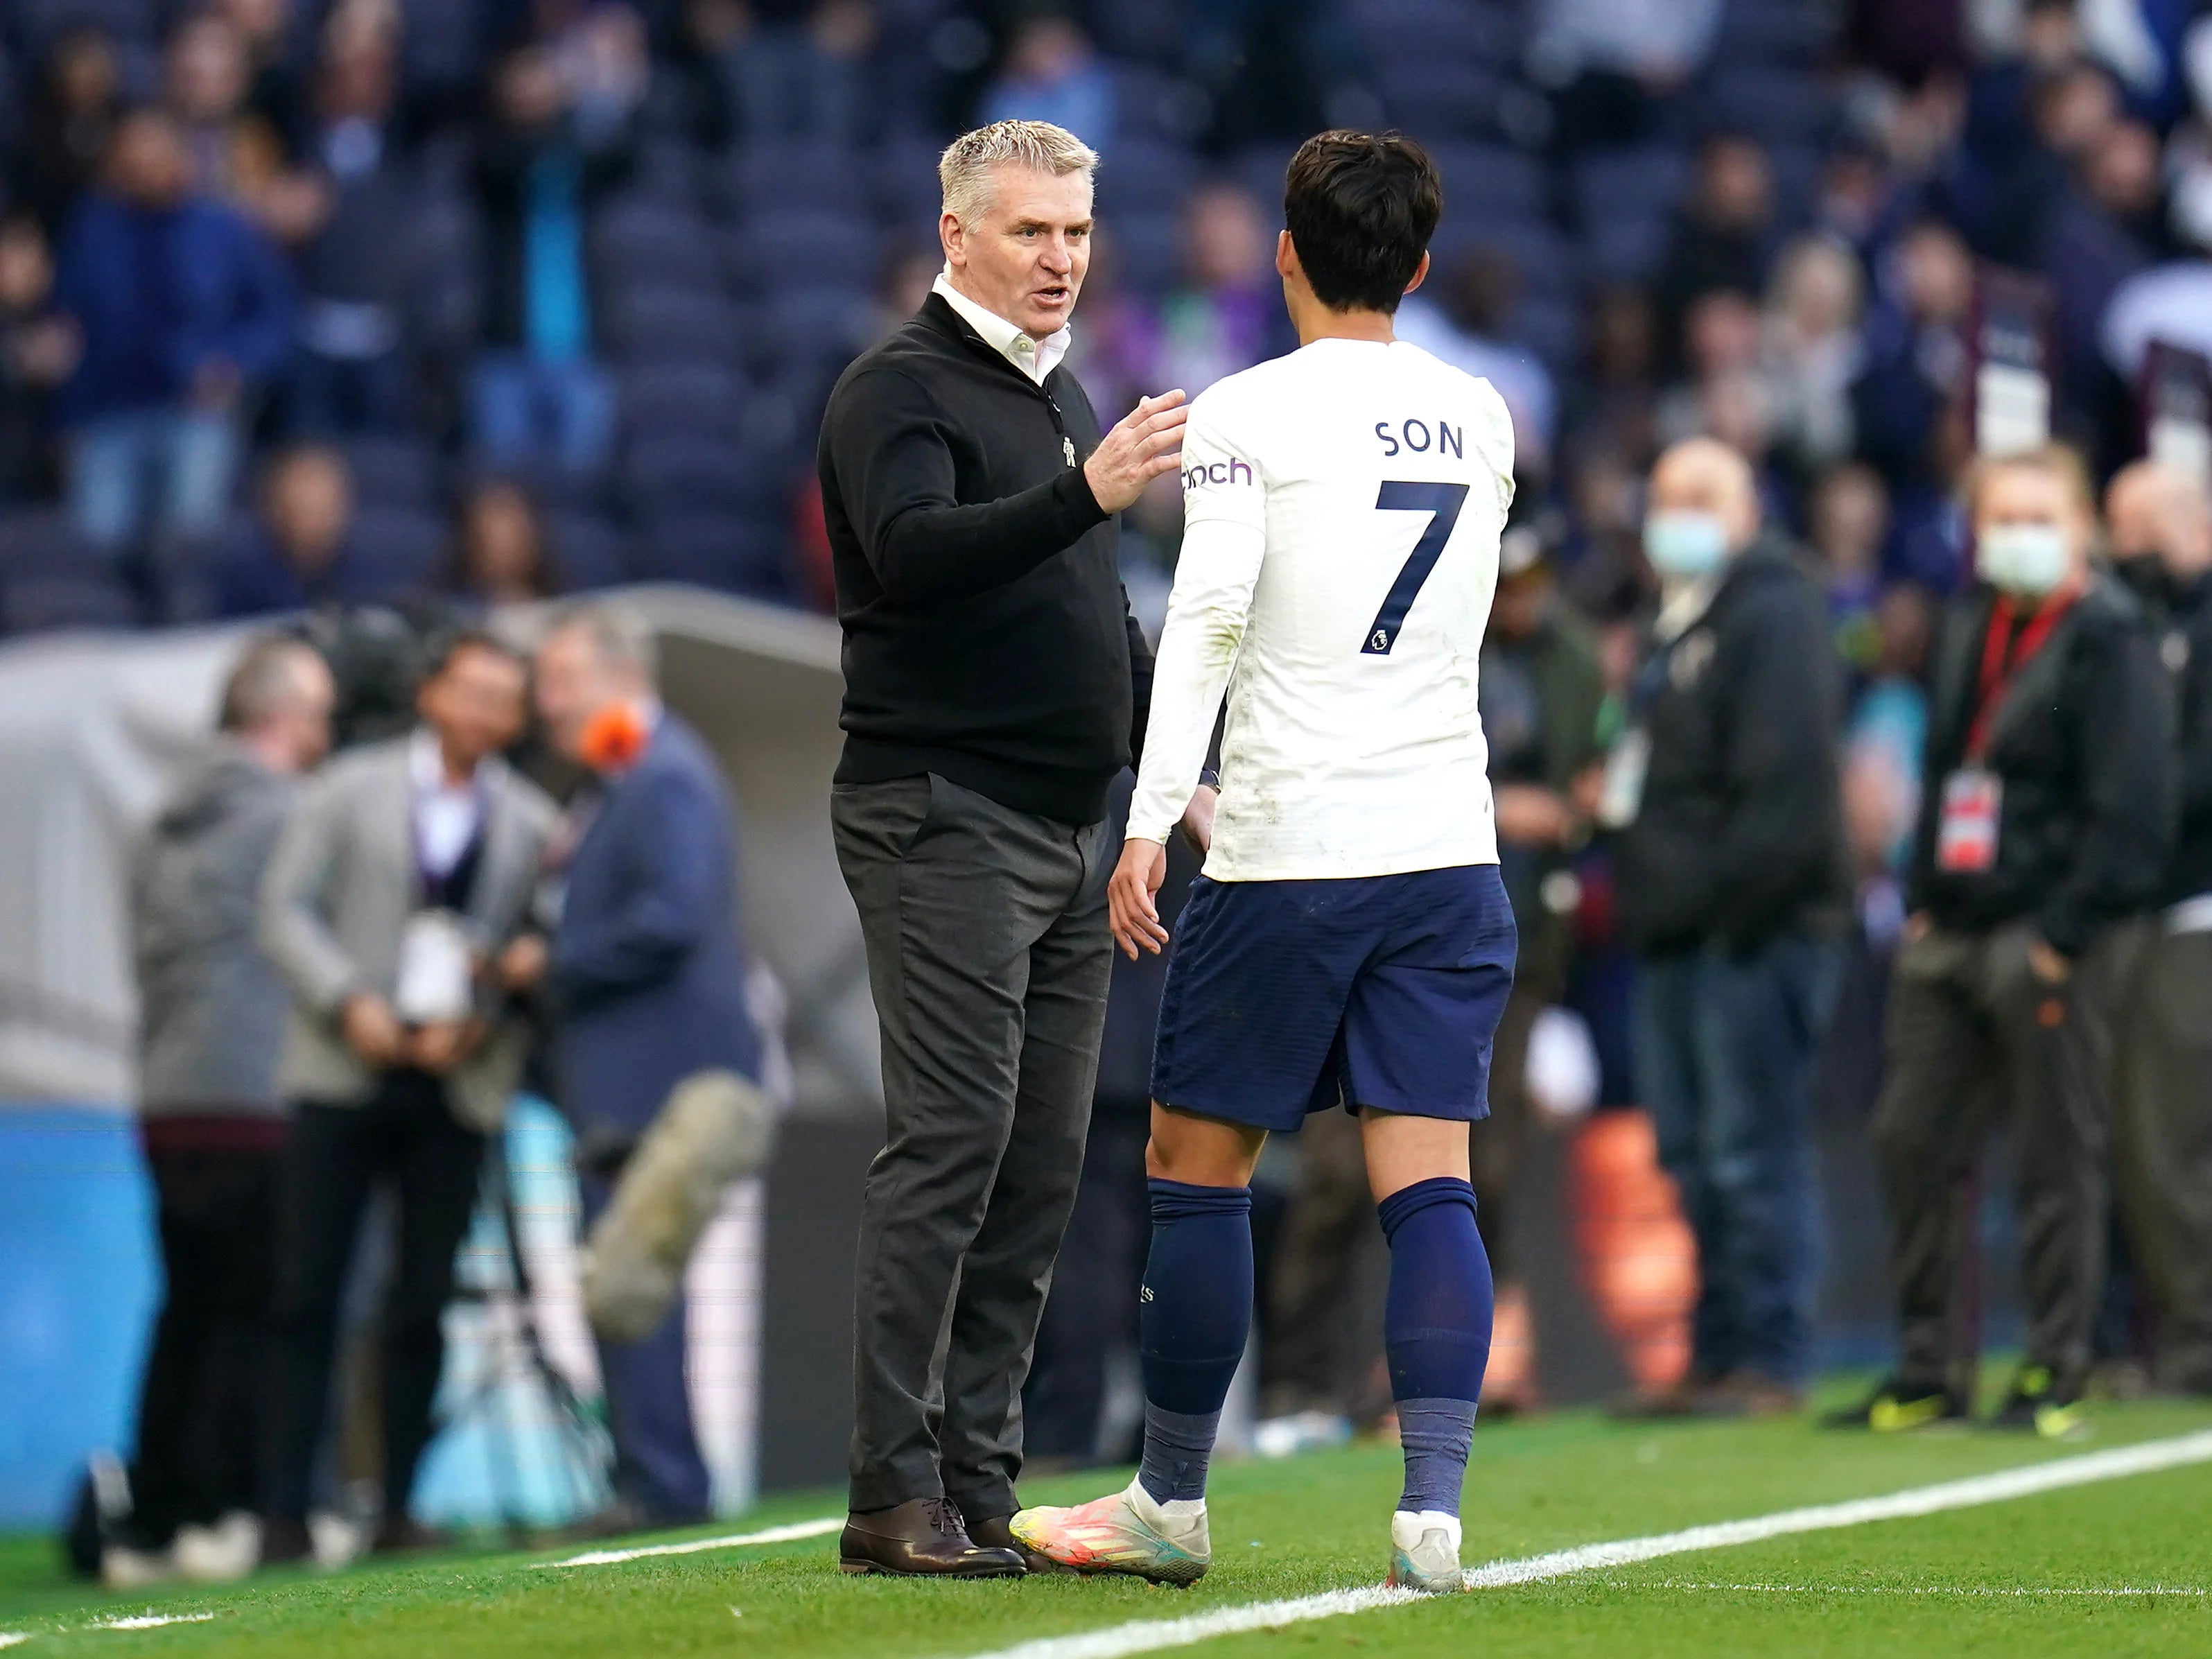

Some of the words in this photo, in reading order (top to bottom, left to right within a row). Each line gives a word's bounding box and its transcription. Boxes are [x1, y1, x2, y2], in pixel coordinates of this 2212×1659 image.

[1375, 419, 1463, 460] SON
[1181, 457, 1252, 489] inch
[1360, 480, 1470, 655] 7
